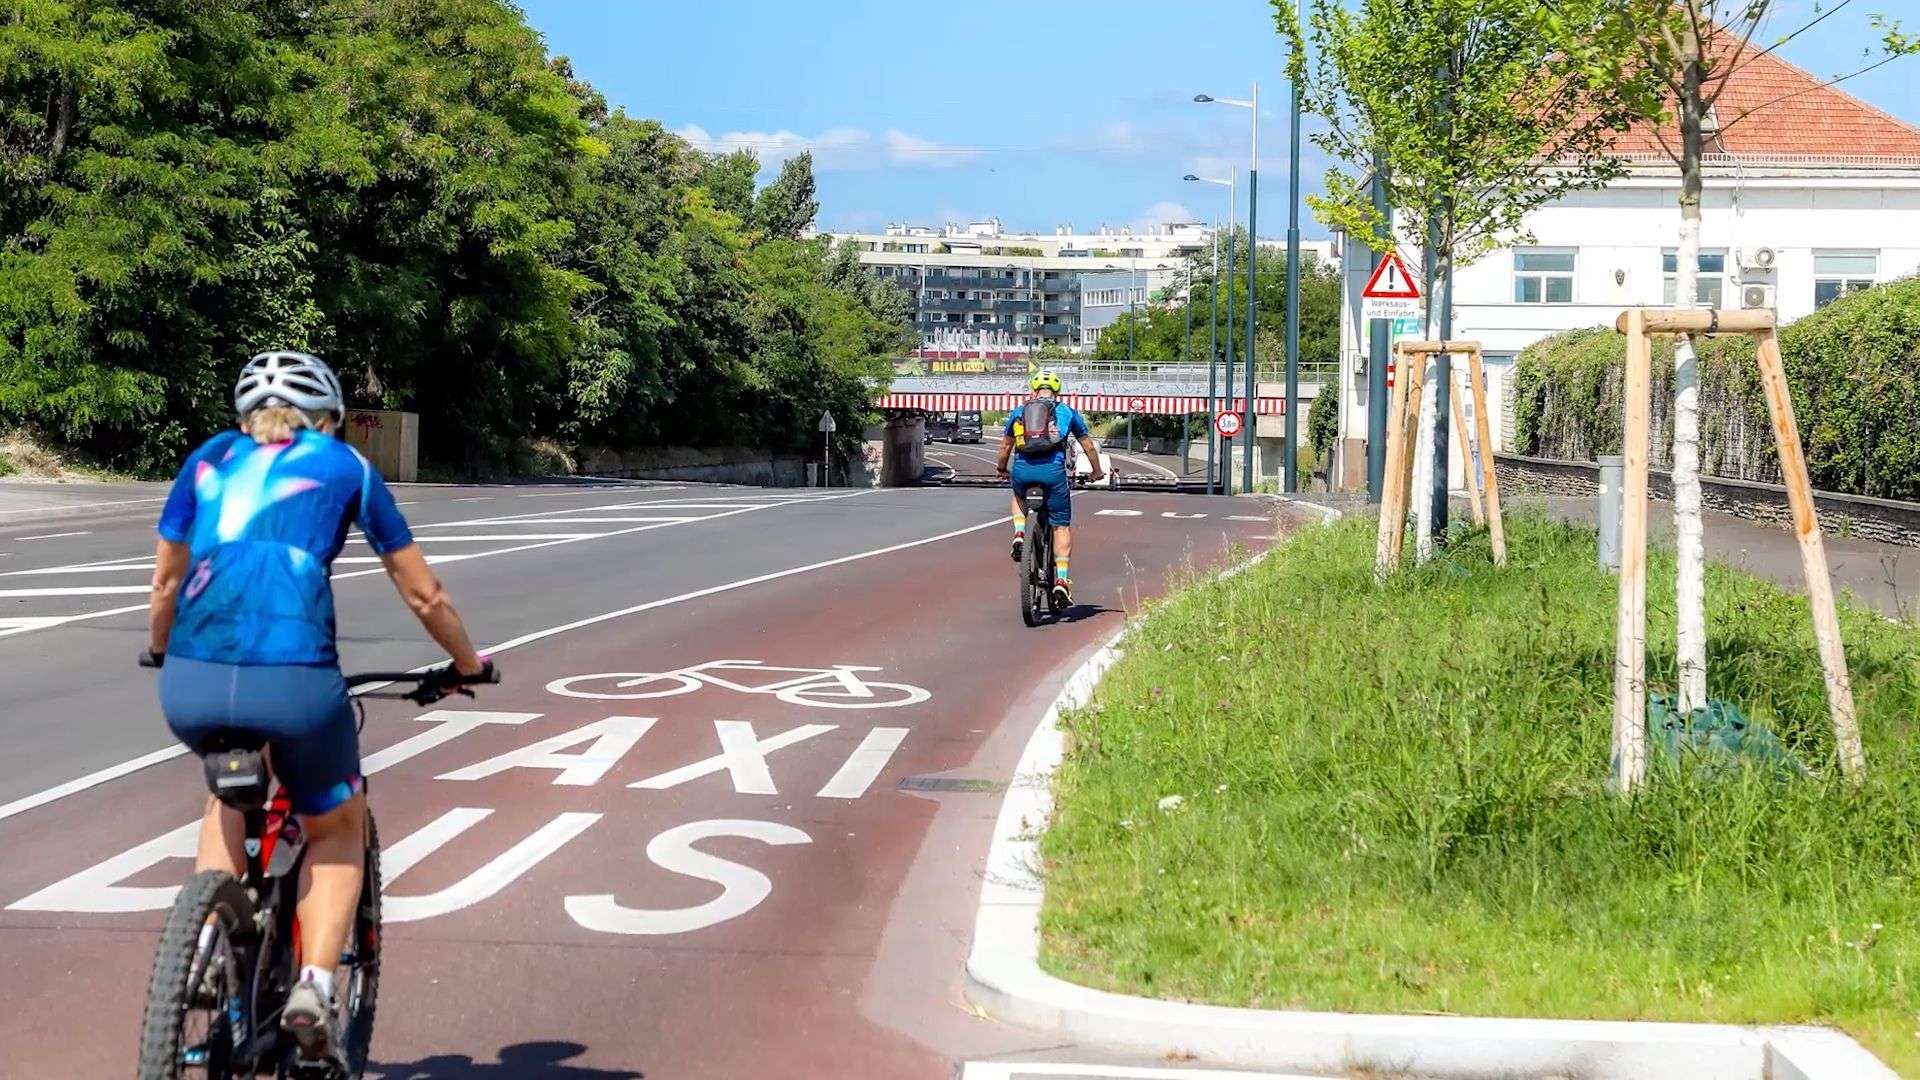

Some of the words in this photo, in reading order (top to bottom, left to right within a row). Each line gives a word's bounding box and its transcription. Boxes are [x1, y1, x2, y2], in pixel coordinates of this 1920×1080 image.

[1366, 309, 1382, 317] und
[1383, 309, 1415, 318] Einfahrt
[931, 360, 963, 373] BILLA
[964, 362, 984, 372] PLUS
[361, 709, 910, 799] TAXI
